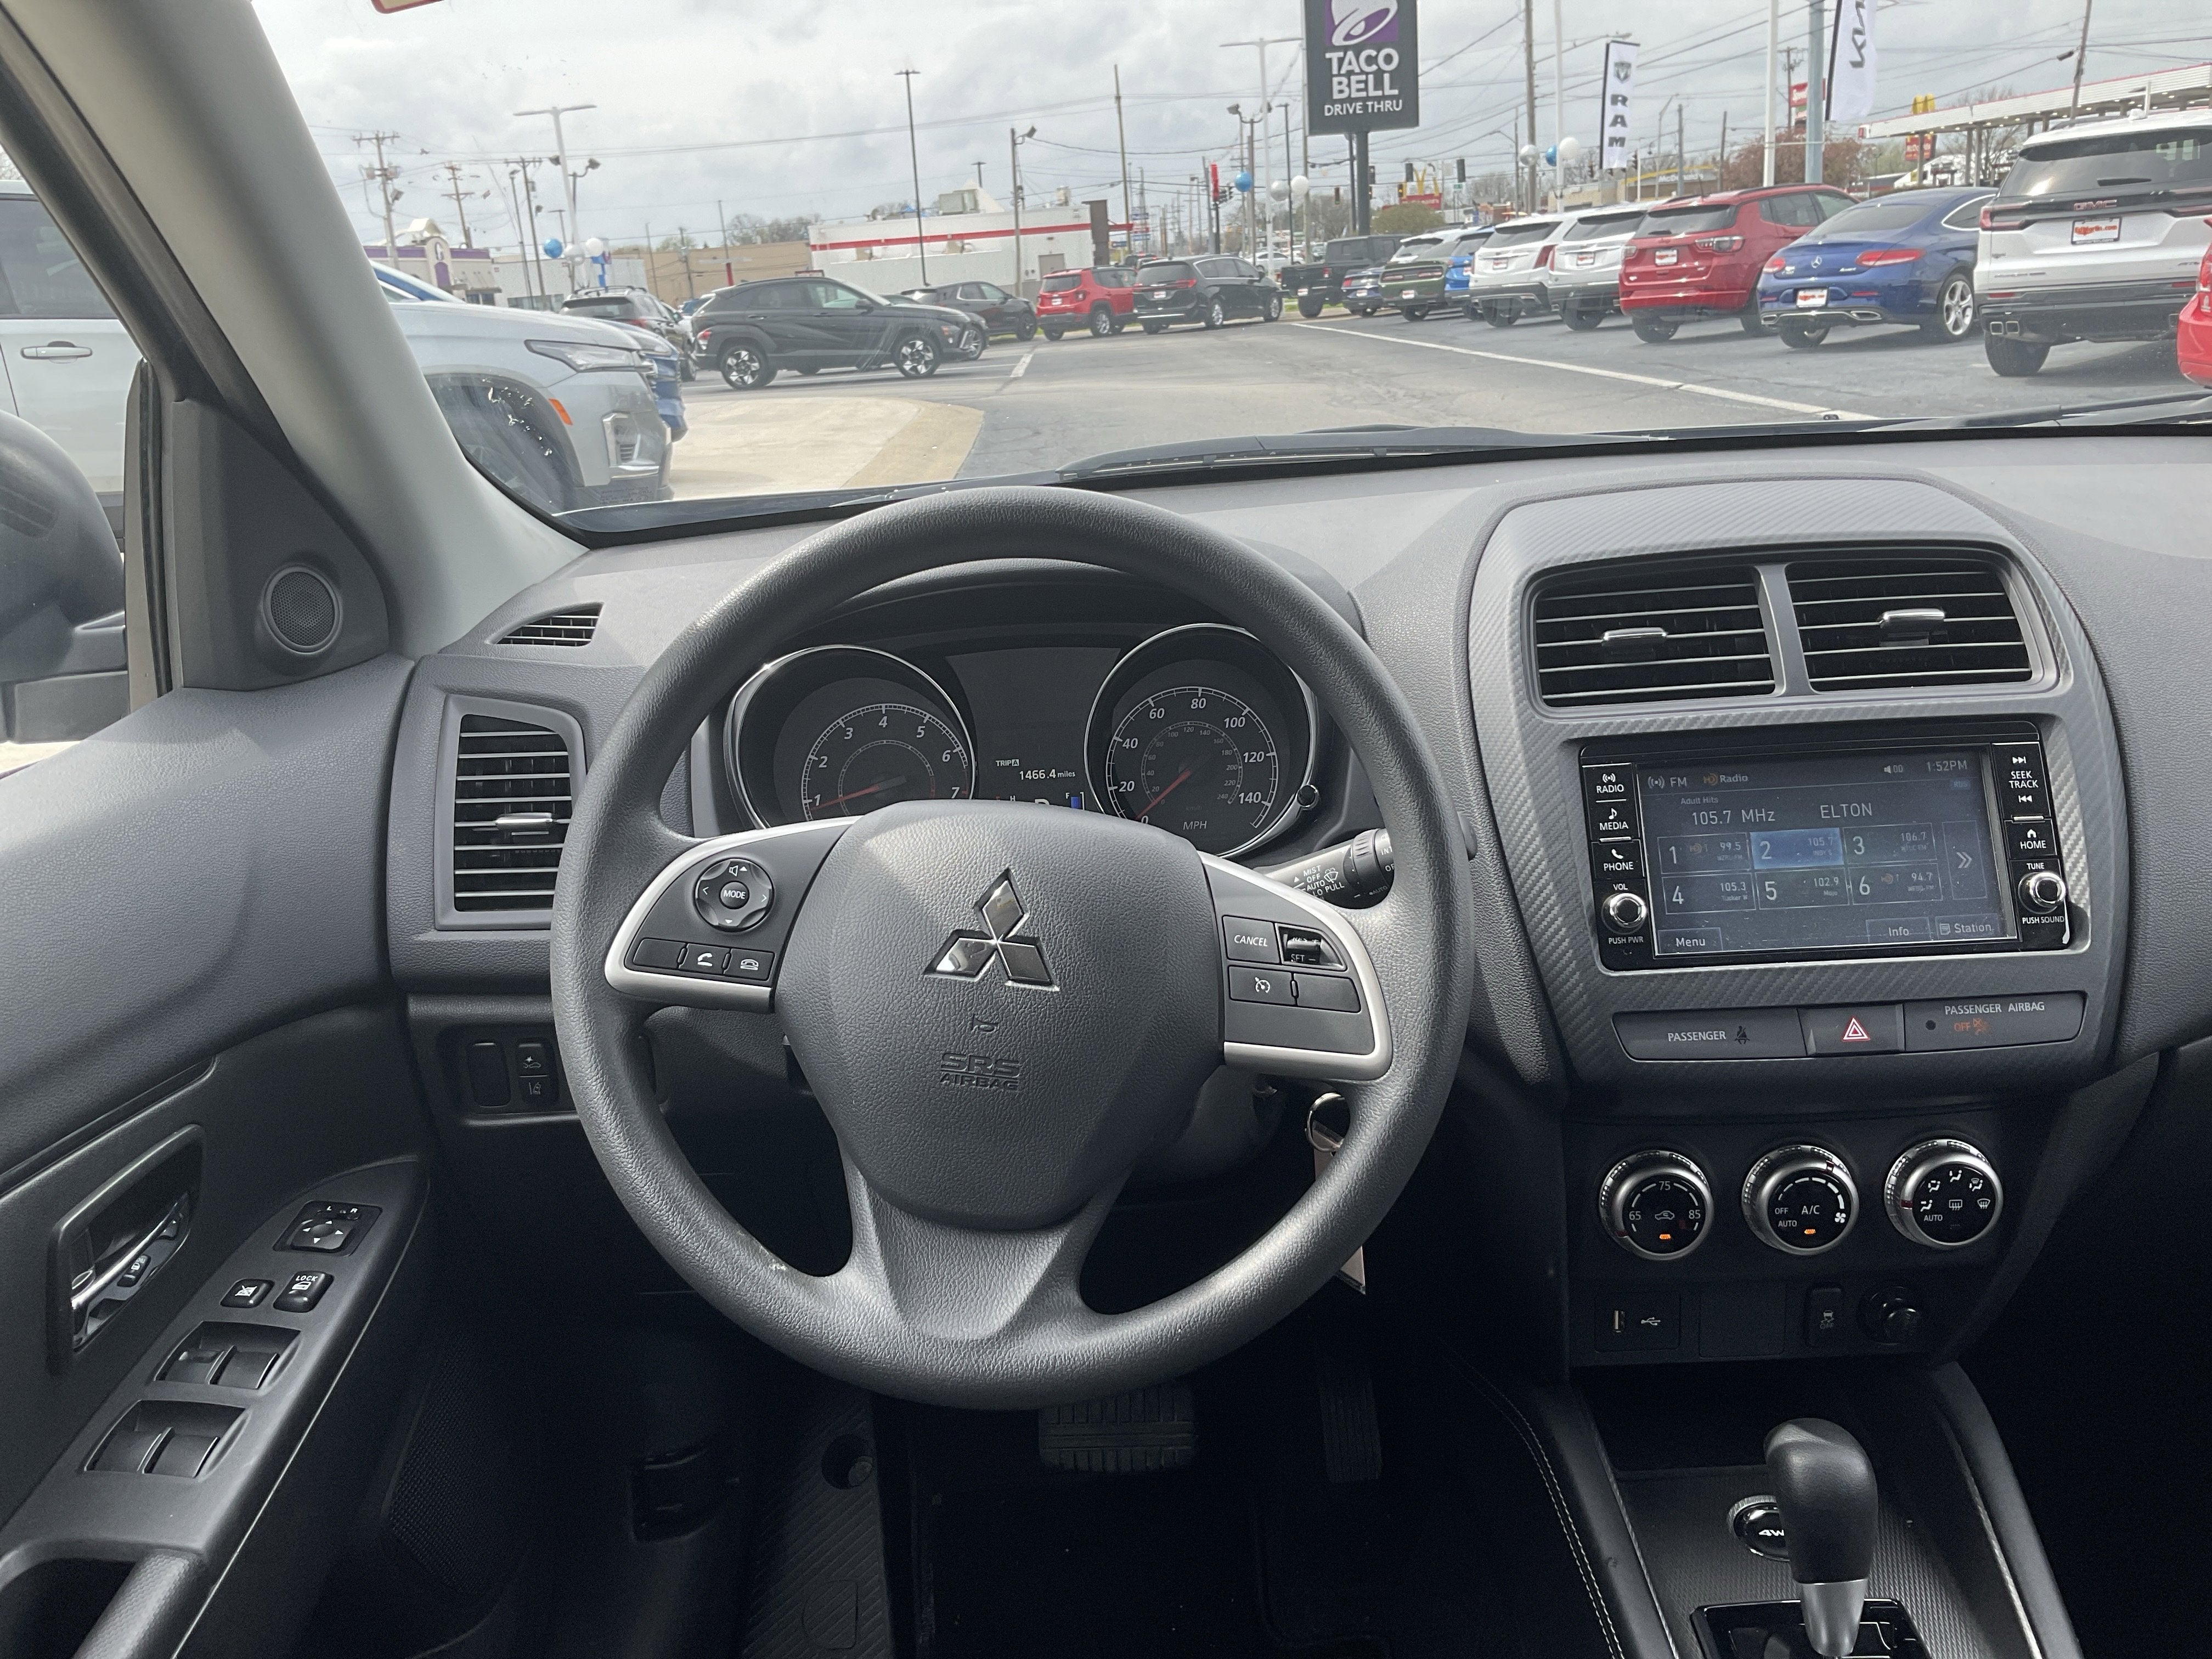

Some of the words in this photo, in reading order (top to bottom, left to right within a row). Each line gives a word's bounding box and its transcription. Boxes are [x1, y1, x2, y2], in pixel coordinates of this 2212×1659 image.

[1325, 48, 1399, 74] TACO
[1332, 74, 1398, 99] BELL
[1324, 103, 1363, 116] DRIVE
[1366, 100, 1402, 113] THRU
[1608, 94, 1628, 148] RAM
[2074, 199, 2117, 211] GMC
[1190, 698, 1206, 709] 80
[1149, 708, 1165, 719] 60
[878, 716, 888, 728] 4
[1223, 716, 1246, 728] 100
[844, 727, 854, 740] 3
[916, 726, 926, 738] 5
[1122, 738, 1138, 749] 40
[941, 749, 951, 762] 6
[1243, 751, 1265, 763] 120
[819, 755, 828, 768] 2
[1927, 760, 1967, 772] 1:52PM
[1019, 769, 1056, 780] 1466.4
[1720, 774, 1748, 783] Radio
[2011, 770, 2033, 780] SEEK
[1119, 781, 1136, 792] 20
[1671, 777, 1687, 787] FM
[2008, 780, 2039, 789] TRACK
[951, 787, 960, 799] 7
[1596, 785, 1624, 793] RADIO
[814, 794, 821, 806] 1
[1238, 792, 1262, 804] 140
[1820, 803, 1872, 819] ELTON
[1692, 810, 1731, 825] 105.7
[1741, 809, 1776, 822] MHz
[1183, 820, 1207, 831] MPH
[1599, 822, 1629, 831] MEDIA
[1808, 837, 1833, 846] 105.7
[1900, 832, 1926, 841] 106.7
[1720, 842, 1741, 851] 99.5
[1759, 841, 1772, 860] 2
[1853, 836, 1865, 855] 3
[2020, 840, 2046, 850] HOME
[1669, 846, 1677, 865] 1
[1303, 865, 1321, 877] MIST
[1603, 862, 1634, 871] PHONE
[1306, 873, 1321, 883] OFF
[1814, 877, 1838, 887] 102.9
[1911, 872, 1933, 882] 94.7
[1307, 880, 1325, 891] AUTO
[1324, 882, 1345, 893] PULL
[1373, 885, 1388, 895] AUTO
[1720, 882, 1746, 892] 105.3
[1764, 881, 1777, 900] 5
[1859, 876, 1870, 895] 6
[723, 890, 746, 900] MODE
[1672, 885, 1684, 904] 4
[1888, 927, 1909, 936] Info
[1954, 922, 1992, 933] Station
[1234, 934, 1268, 947] CANCEL
[1675, 936, 1706, 947] Menu
[1945, 1003, 2002, 1015] PASSENGER
[2008, 1001, 2045, 1012] AIRBAG
[1954, 1021, 1971, 1031] OFF
[1668, 1030, 1726, 1042] PASSENGER
[941, 1053, 1020, 1077] SRS
[1659, 1181, 1671, 1191] 75
[1629, 1211, 1641, 1221] 65
[1689, 1210, 1701, 1220] 85
[1774, 1207, 1789, 1215] OFF
[1801, 1205, 1820, 1216] A/C
[1778, 1220, 1797, 1228] AUTO
